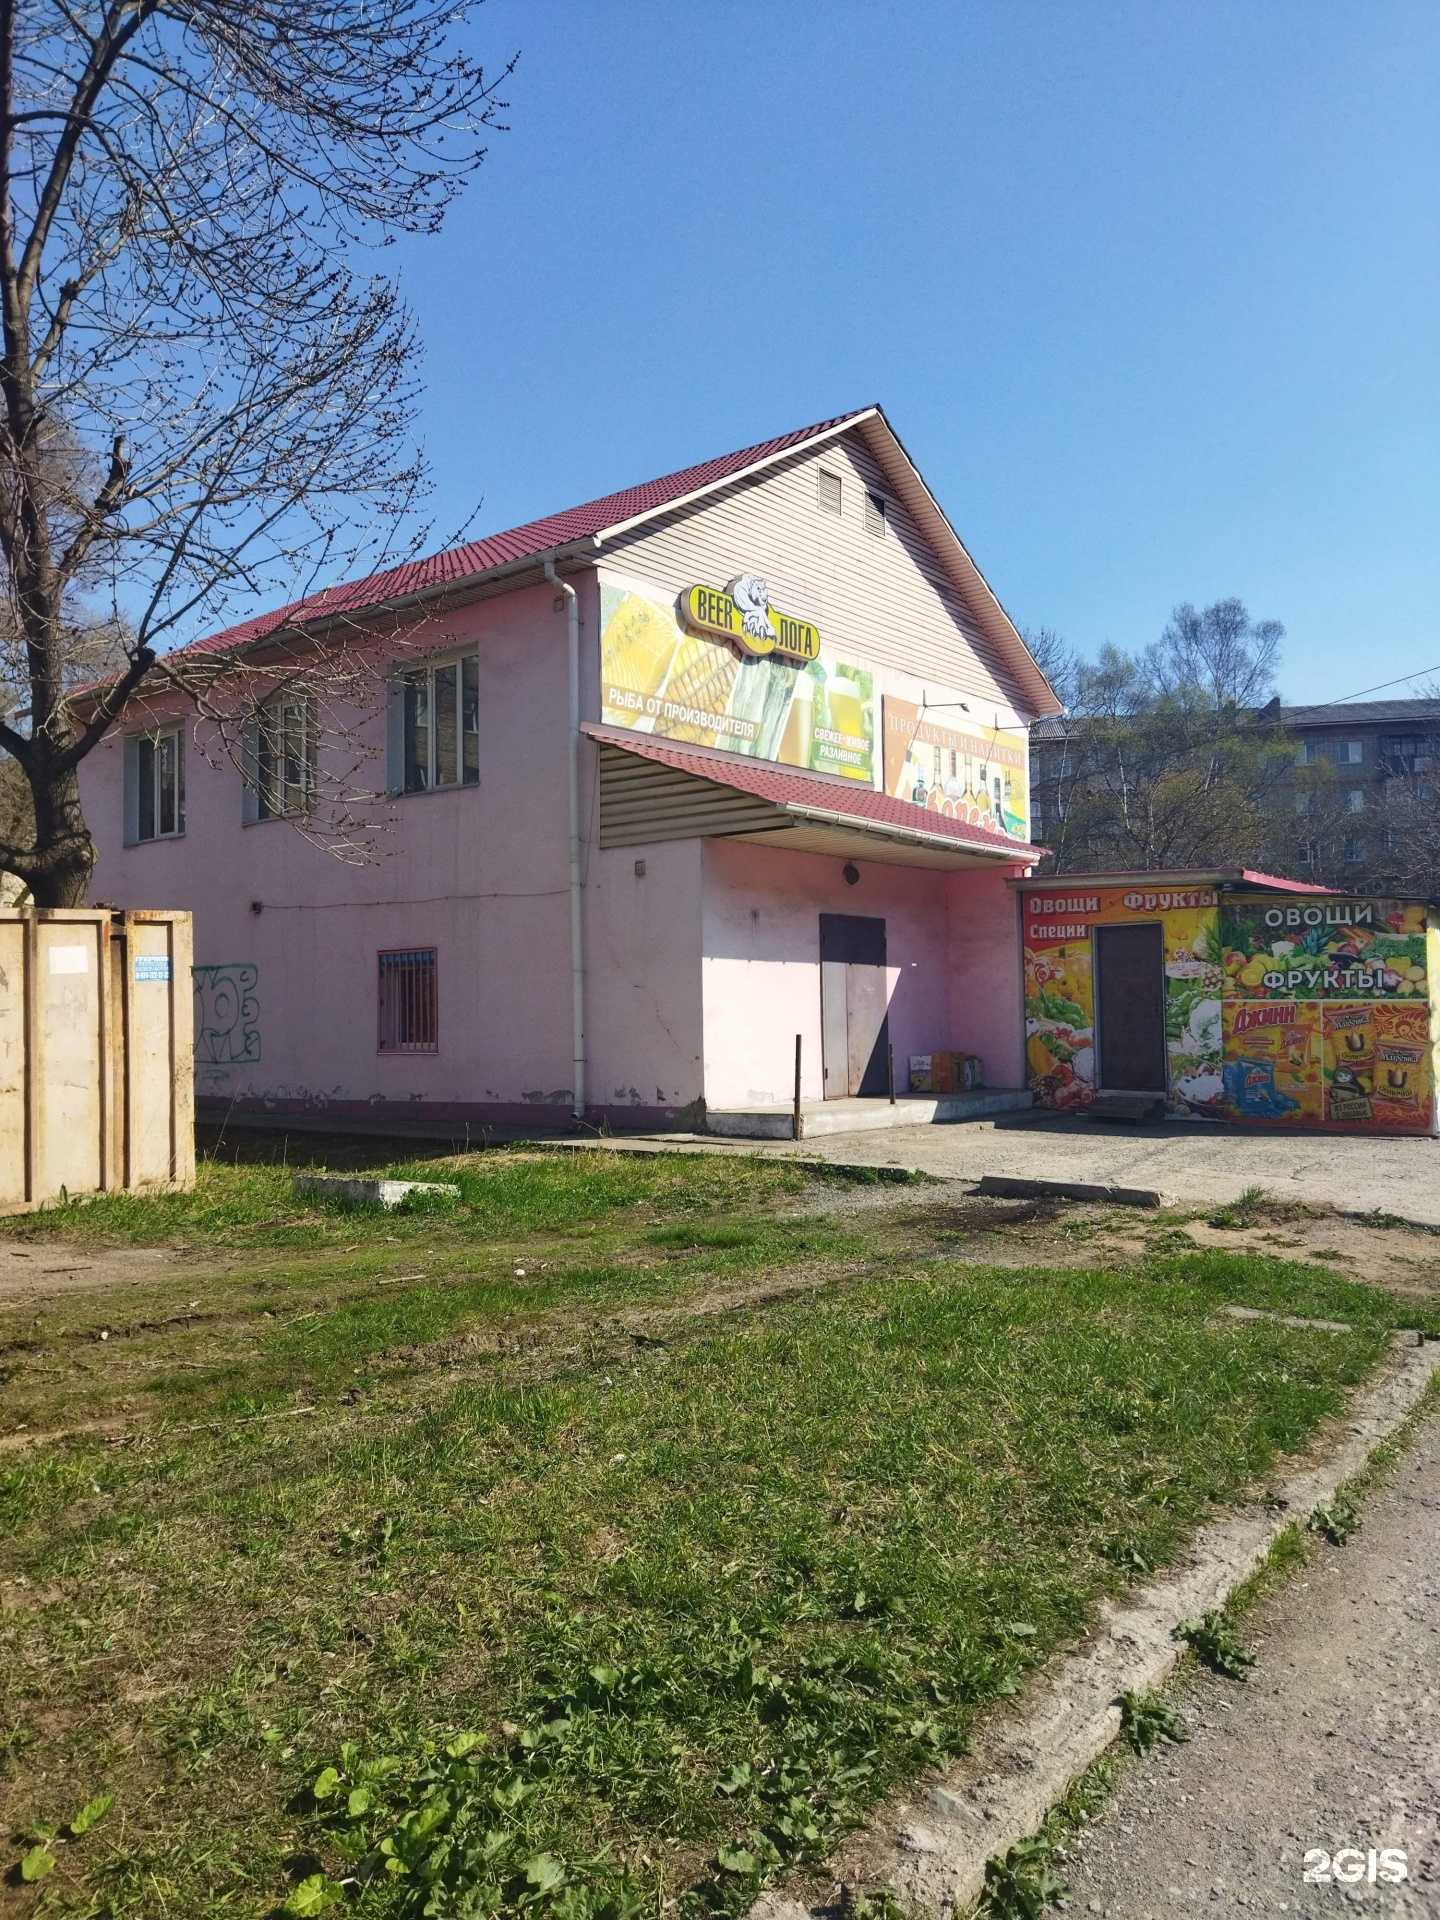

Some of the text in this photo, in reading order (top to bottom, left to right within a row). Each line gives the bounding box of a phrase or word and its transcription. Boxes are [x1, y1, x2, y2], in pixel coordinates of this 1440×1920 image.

[697, 588, 733, 631] BEER
[779, 619, 813, 657] ЛОГА
[608, 687, 754, 737] РЫБА ОТ ПРОИЗВОДИТЕЛЯ
[1030, 897, 1099, 914] Овощи
[1264, 905, 1373, 927] ОВОЩИ
[1030, 925, 1088, 939] Специи
[1263, 970, 1384, 989] ФРУКТЫ
